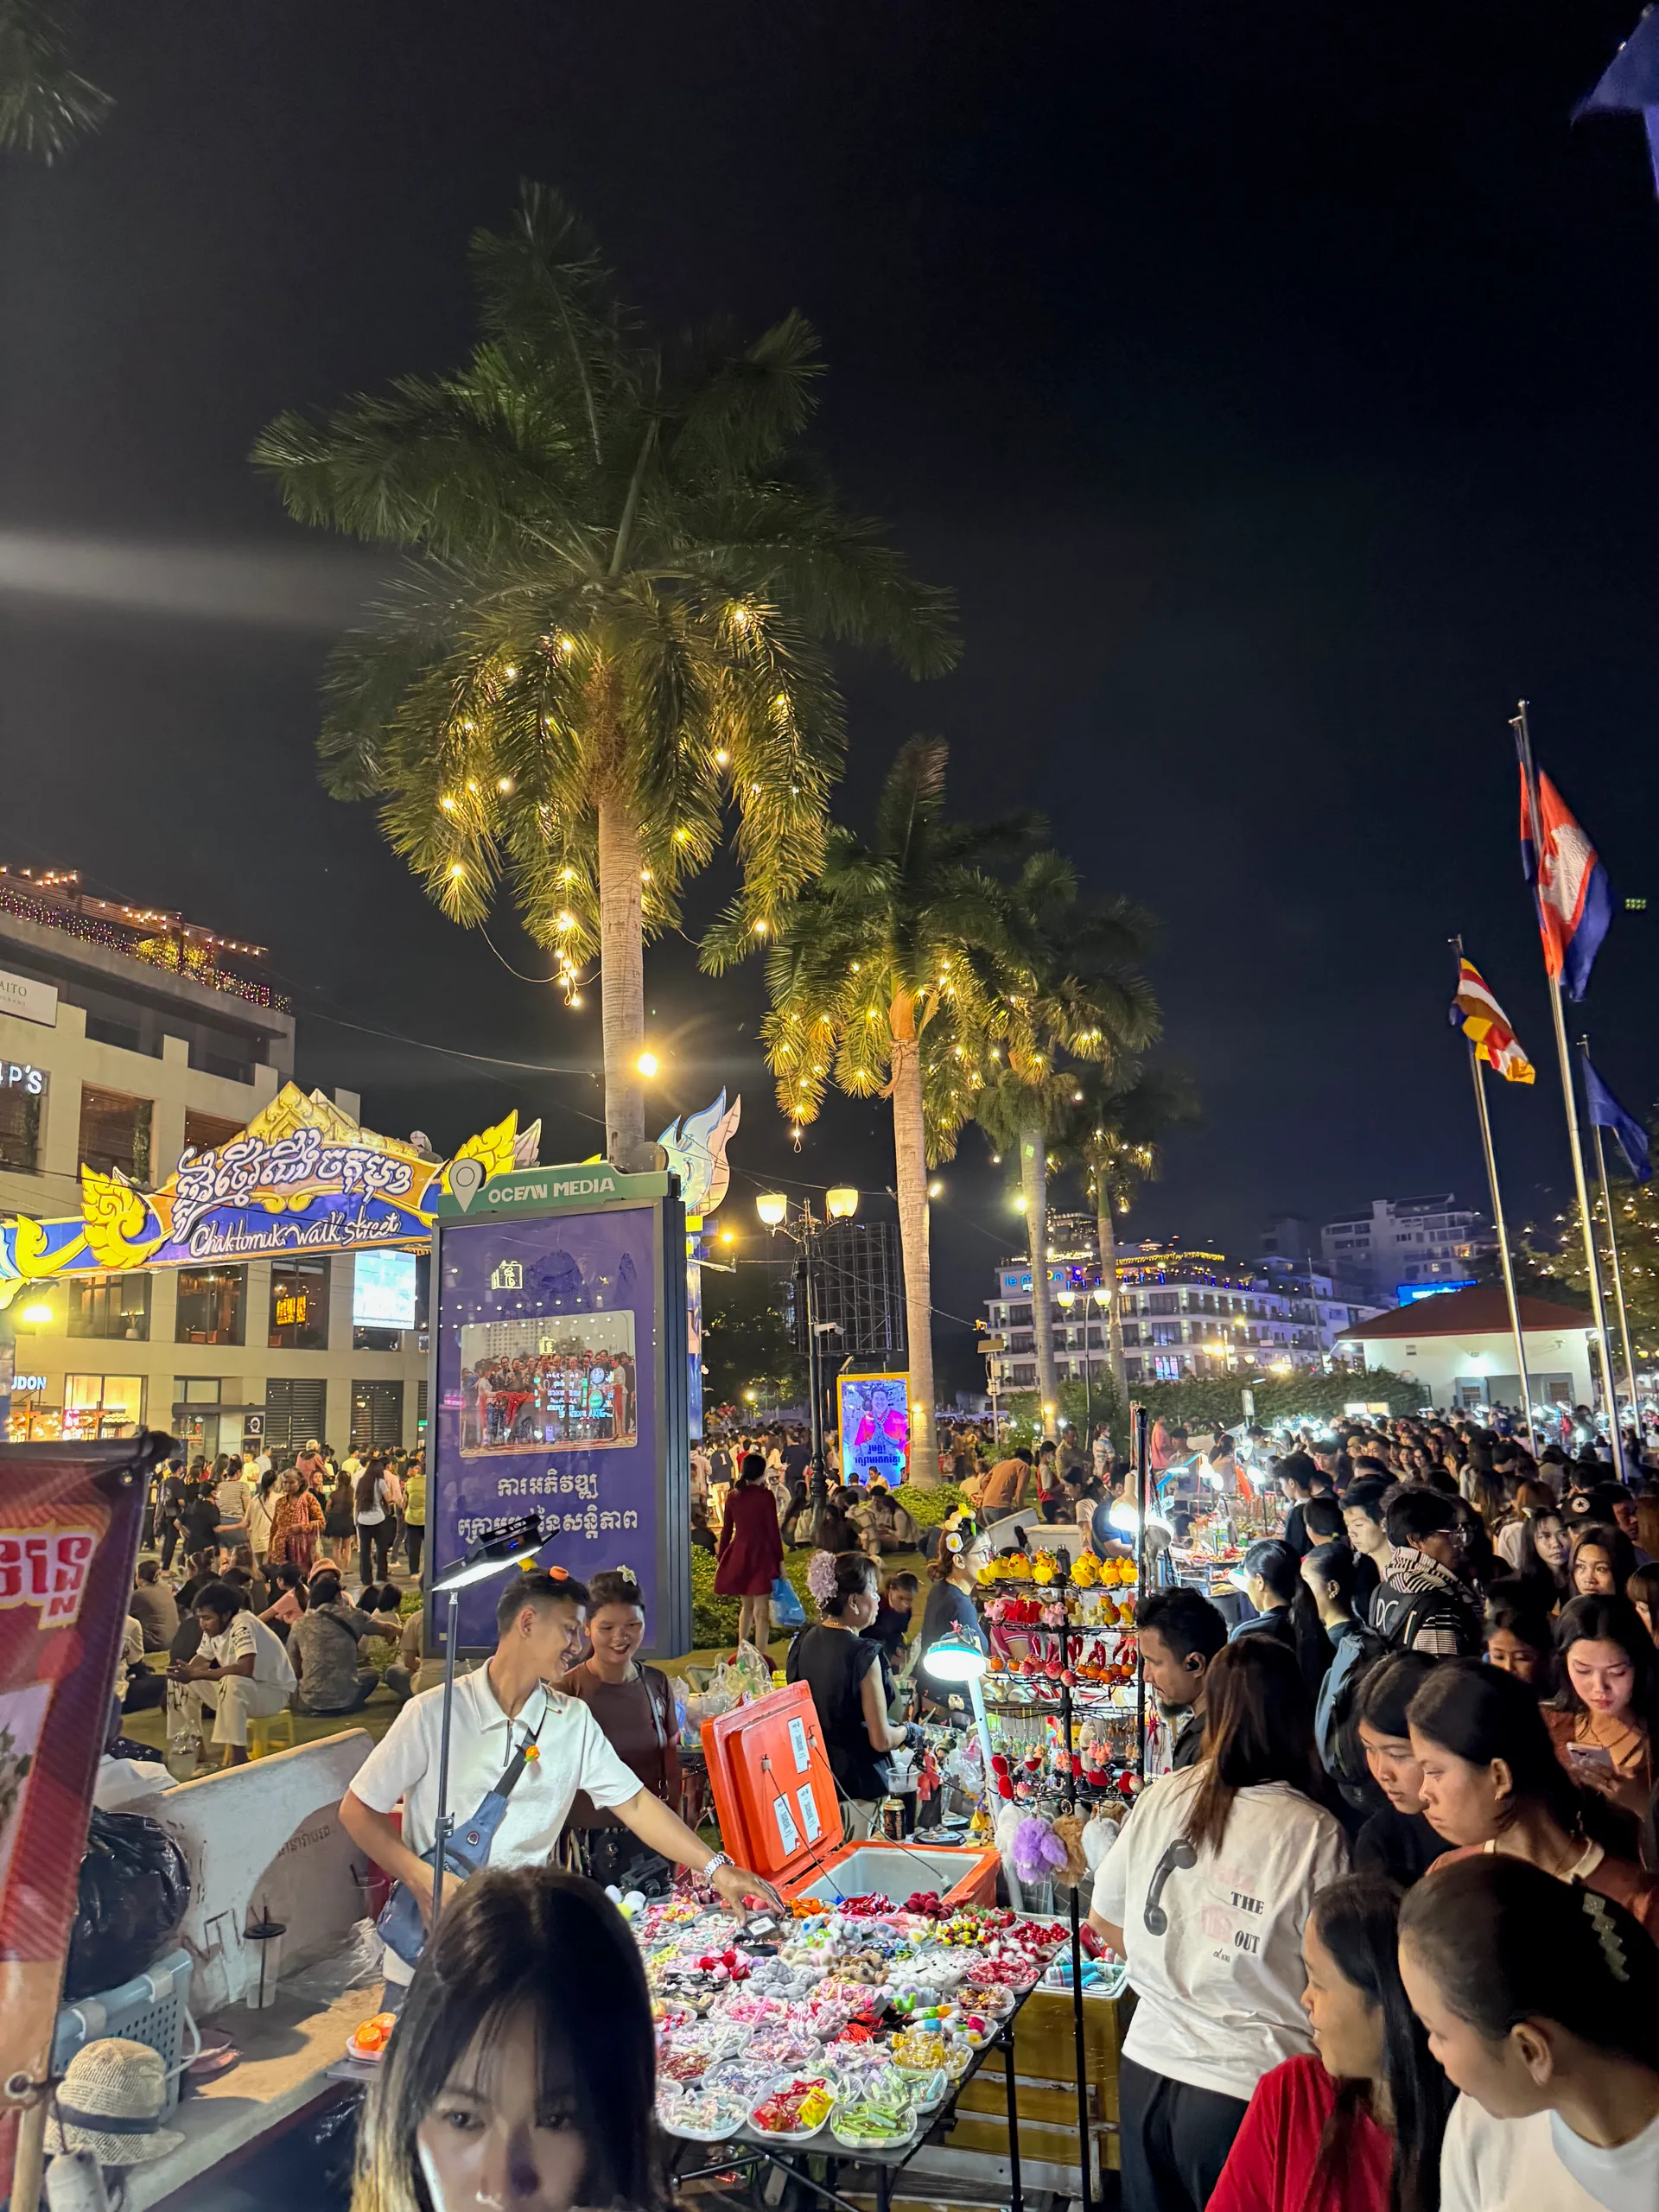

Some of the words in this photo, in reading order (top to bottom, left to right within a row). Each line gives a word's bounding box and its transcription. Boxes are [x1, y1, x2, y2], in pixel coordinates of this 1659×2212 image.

[488, 1184, 548, 1204] OCEAN
[553, 1177, 615, 1198] MEDIA
[1006, 1275, 1018, 1287] le
[1231, 1891, 1264, 1915] THE
[1235, 1930, 1260, 1954] OUT
